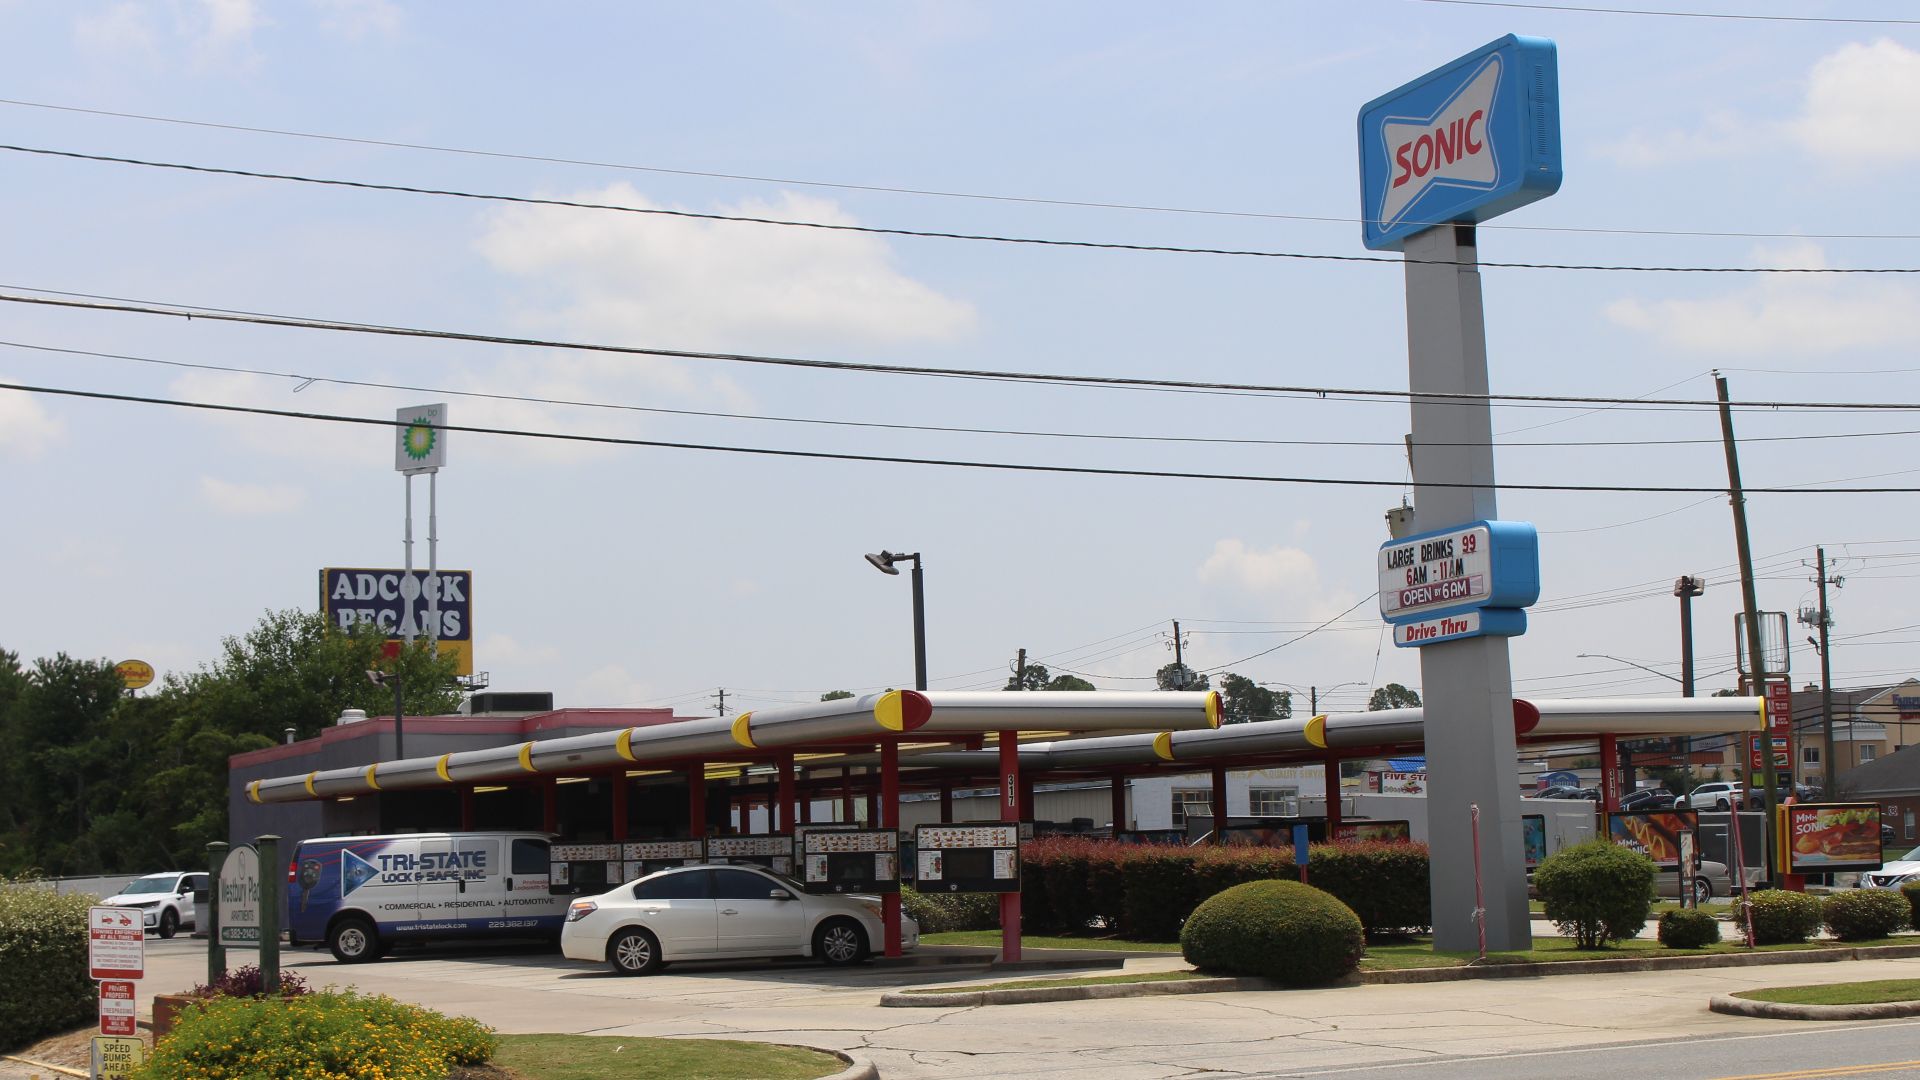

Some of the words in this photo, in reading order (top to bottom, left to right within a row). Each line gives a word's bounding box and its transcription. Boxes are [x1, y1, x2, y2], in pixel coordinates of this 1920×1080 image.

[1393, 110, 1483, 189] SONIC
[1387, 547, 1415, 570] LARGE
[1421, 539, 1453, 562] DRINKS
[1462, 533, 1477, 553] 99
[1406, 565, 1427, 586] 6AM
[1440, 557, 1464, 580] 11AM
[331, 572, 466, 603] ADCOCK
[1403, 586, 1432, 606] OPEN
[336, 607, 461, 637] PECANS
[1406, 622, 1437, 641] Drive
[1440, 617, 1468, 636] Thru
[1384, 773, 1407, 781] FIVE
[1796, 822, 1830, 836] SONIC
[378, 851, 486, 872] TRI-STATE
[382, 872, 412, 884] LOCK
[414, 871, 424, 882] &
[385, 902, 436, 911] COMMERCIAL
[444, 900, 495, 909] RESIDENTIAL
[503, 897, 555, 906] AUTOMOTIVE
[396, 922, 467, 931] www.tristatelock.com
[488, 920, 538, 929] 229.382.1317
[104, 1044, 130, 1053] SPEED
[104, 1054, 131, 1062] BUMPS
[104, 1063, 131, 1072] AHEAD
